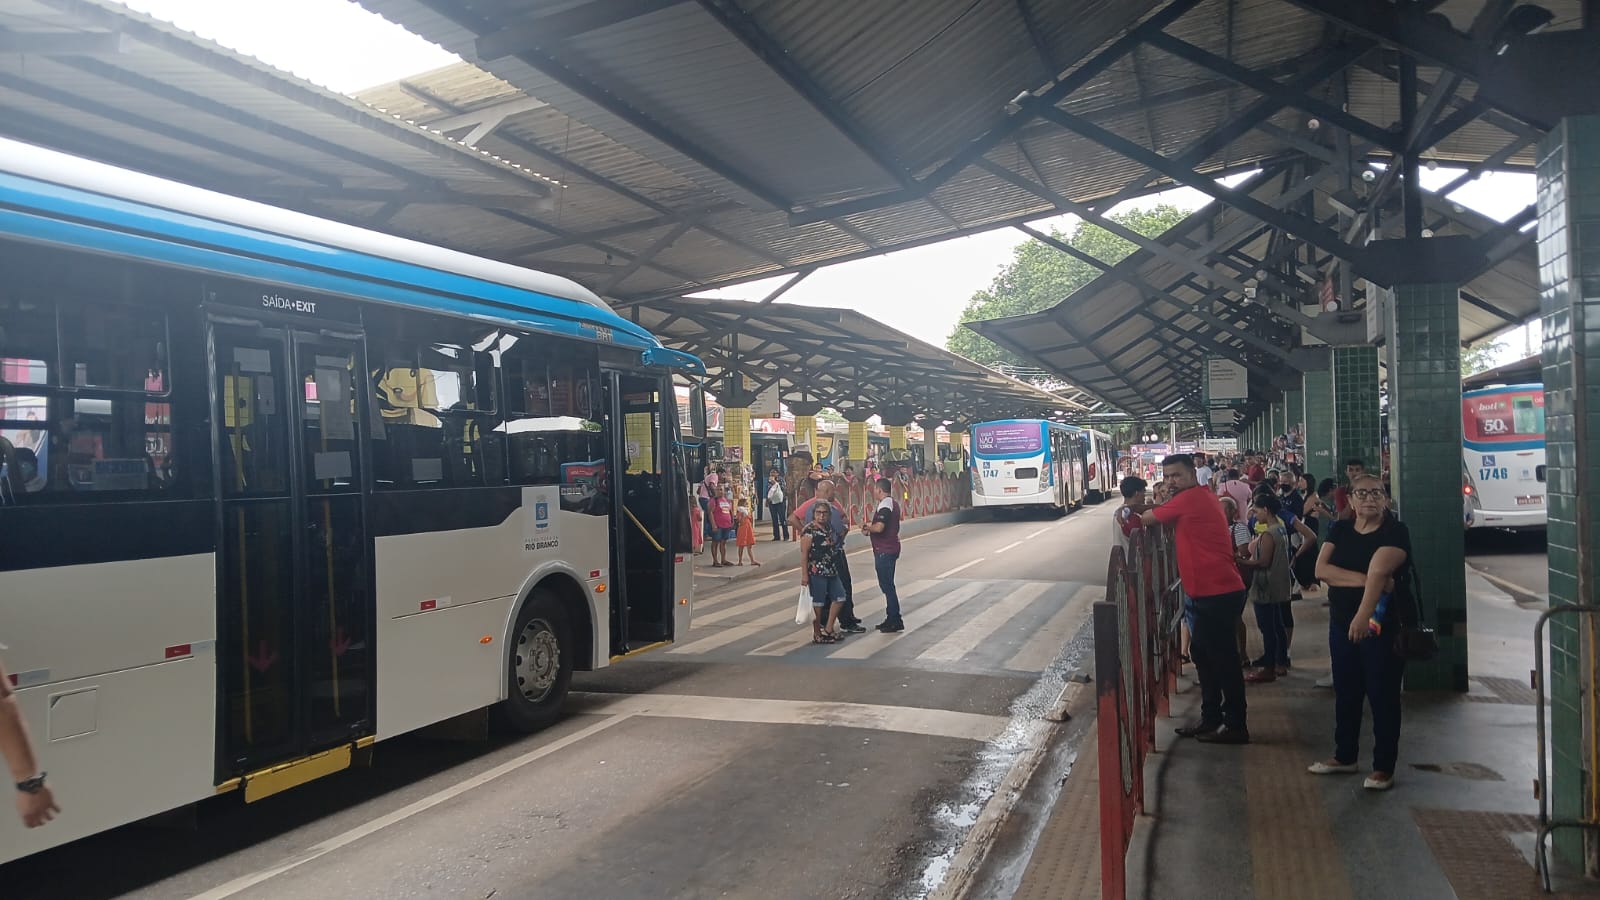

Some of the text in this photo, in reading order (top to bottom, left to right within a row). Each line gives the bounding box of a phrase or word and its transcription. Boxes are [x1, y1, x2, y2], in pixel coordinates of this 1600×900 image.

[983, 469, 999, 478] 1747
[1479, 467, 1508, 480] 1746
[525, 540, 559, 551] RIO BRANCO
